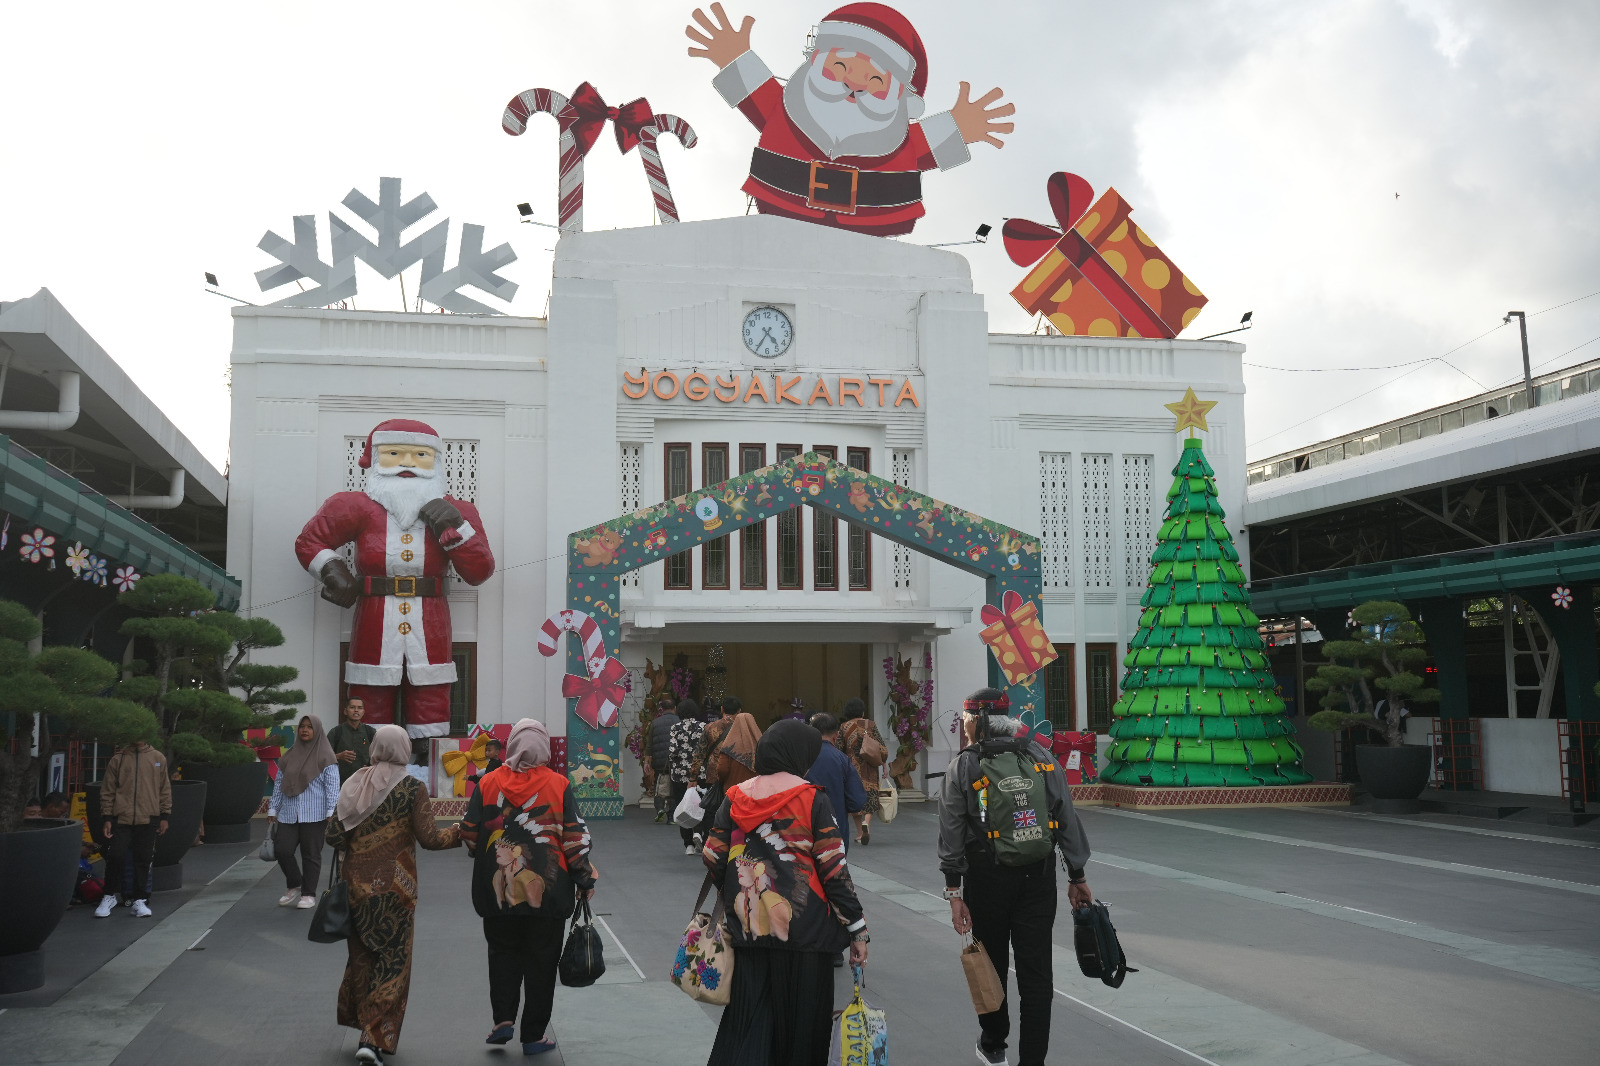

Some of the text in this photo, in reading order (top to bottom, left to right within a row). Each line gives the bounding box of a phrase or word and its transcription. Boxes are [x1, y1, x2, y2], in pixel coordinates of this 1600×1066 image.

[780, 320, 786, 328] 2
[746, 328, 750, 336] 9
[784, 330, 788, 338] 3
[748, 338, 754, 346] 8
[622, 370, 920, 408] YOGYAKARTA
[846, 1011, 864, 1066] RALIA
